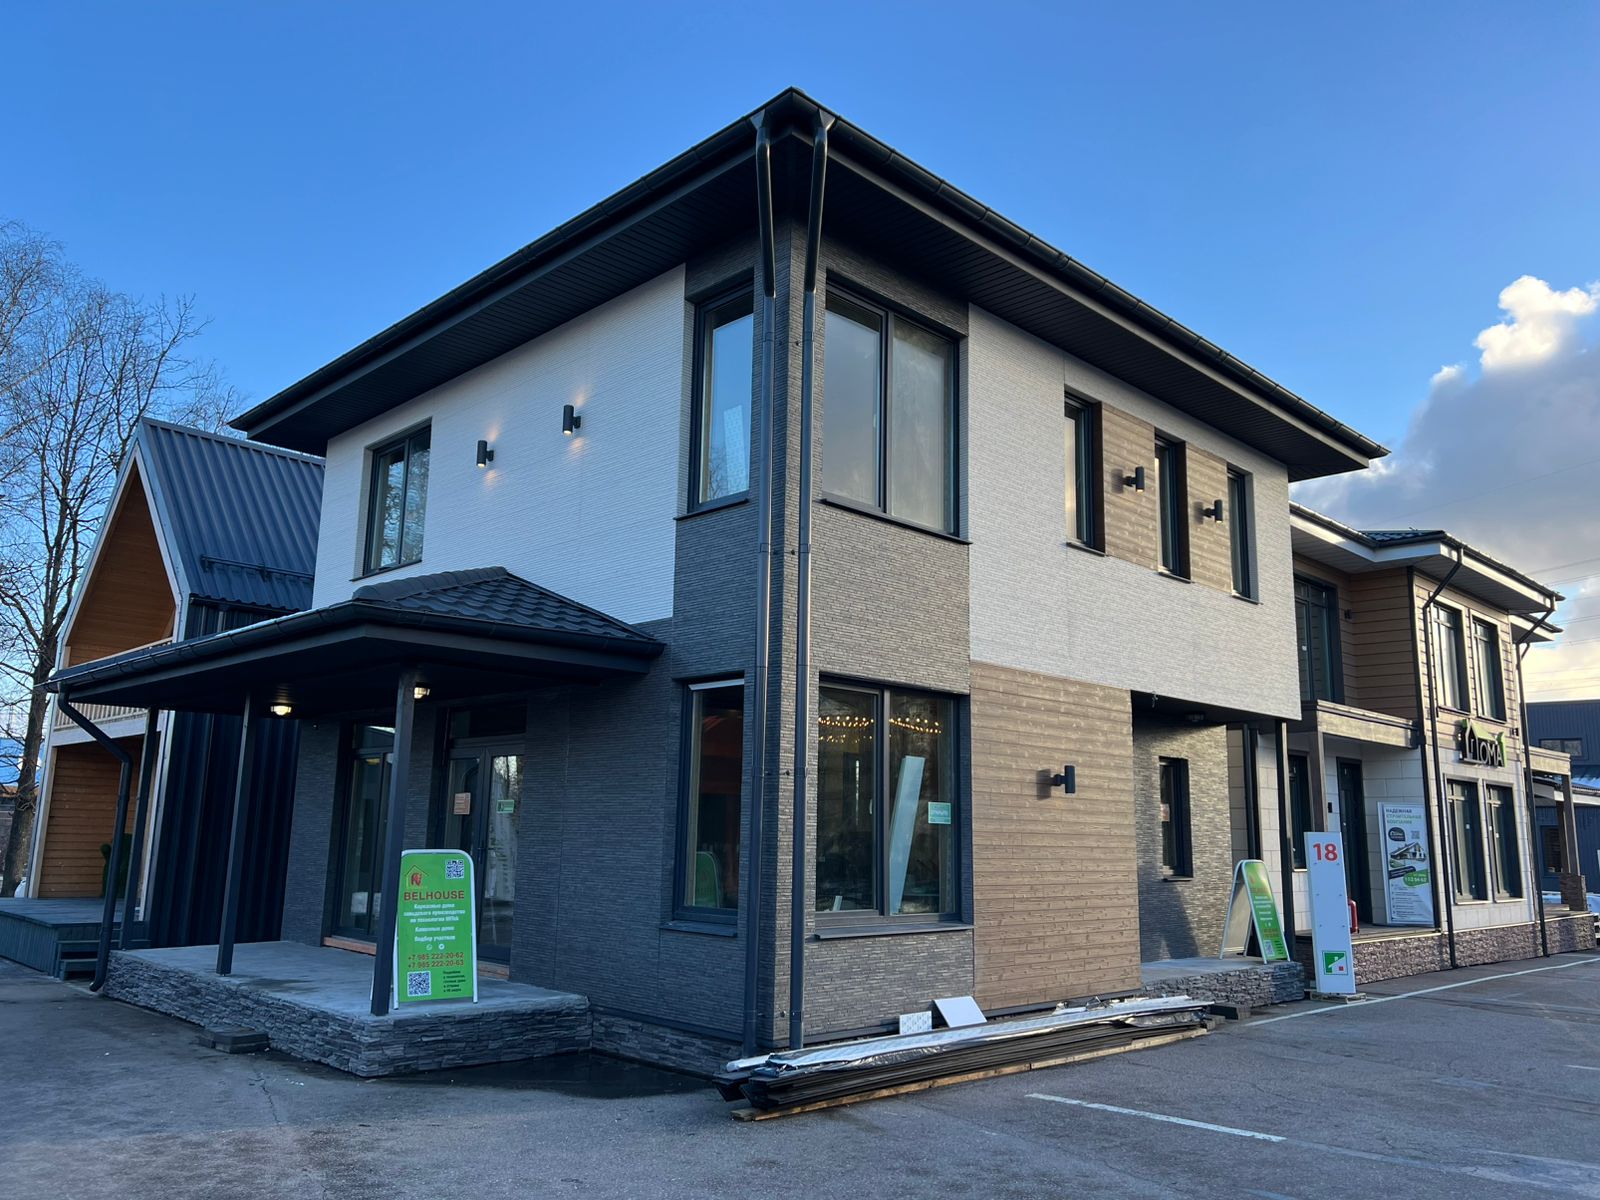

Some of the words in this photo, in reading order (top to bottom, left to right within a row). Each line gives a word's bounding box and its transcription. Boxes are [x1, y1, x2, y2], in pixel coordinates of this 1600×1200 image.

[1313, 843, 1338, 861] 18
[403, 890, 465, 901] BELHOUSE
[431, 951, 464, 960] 222-20-62
